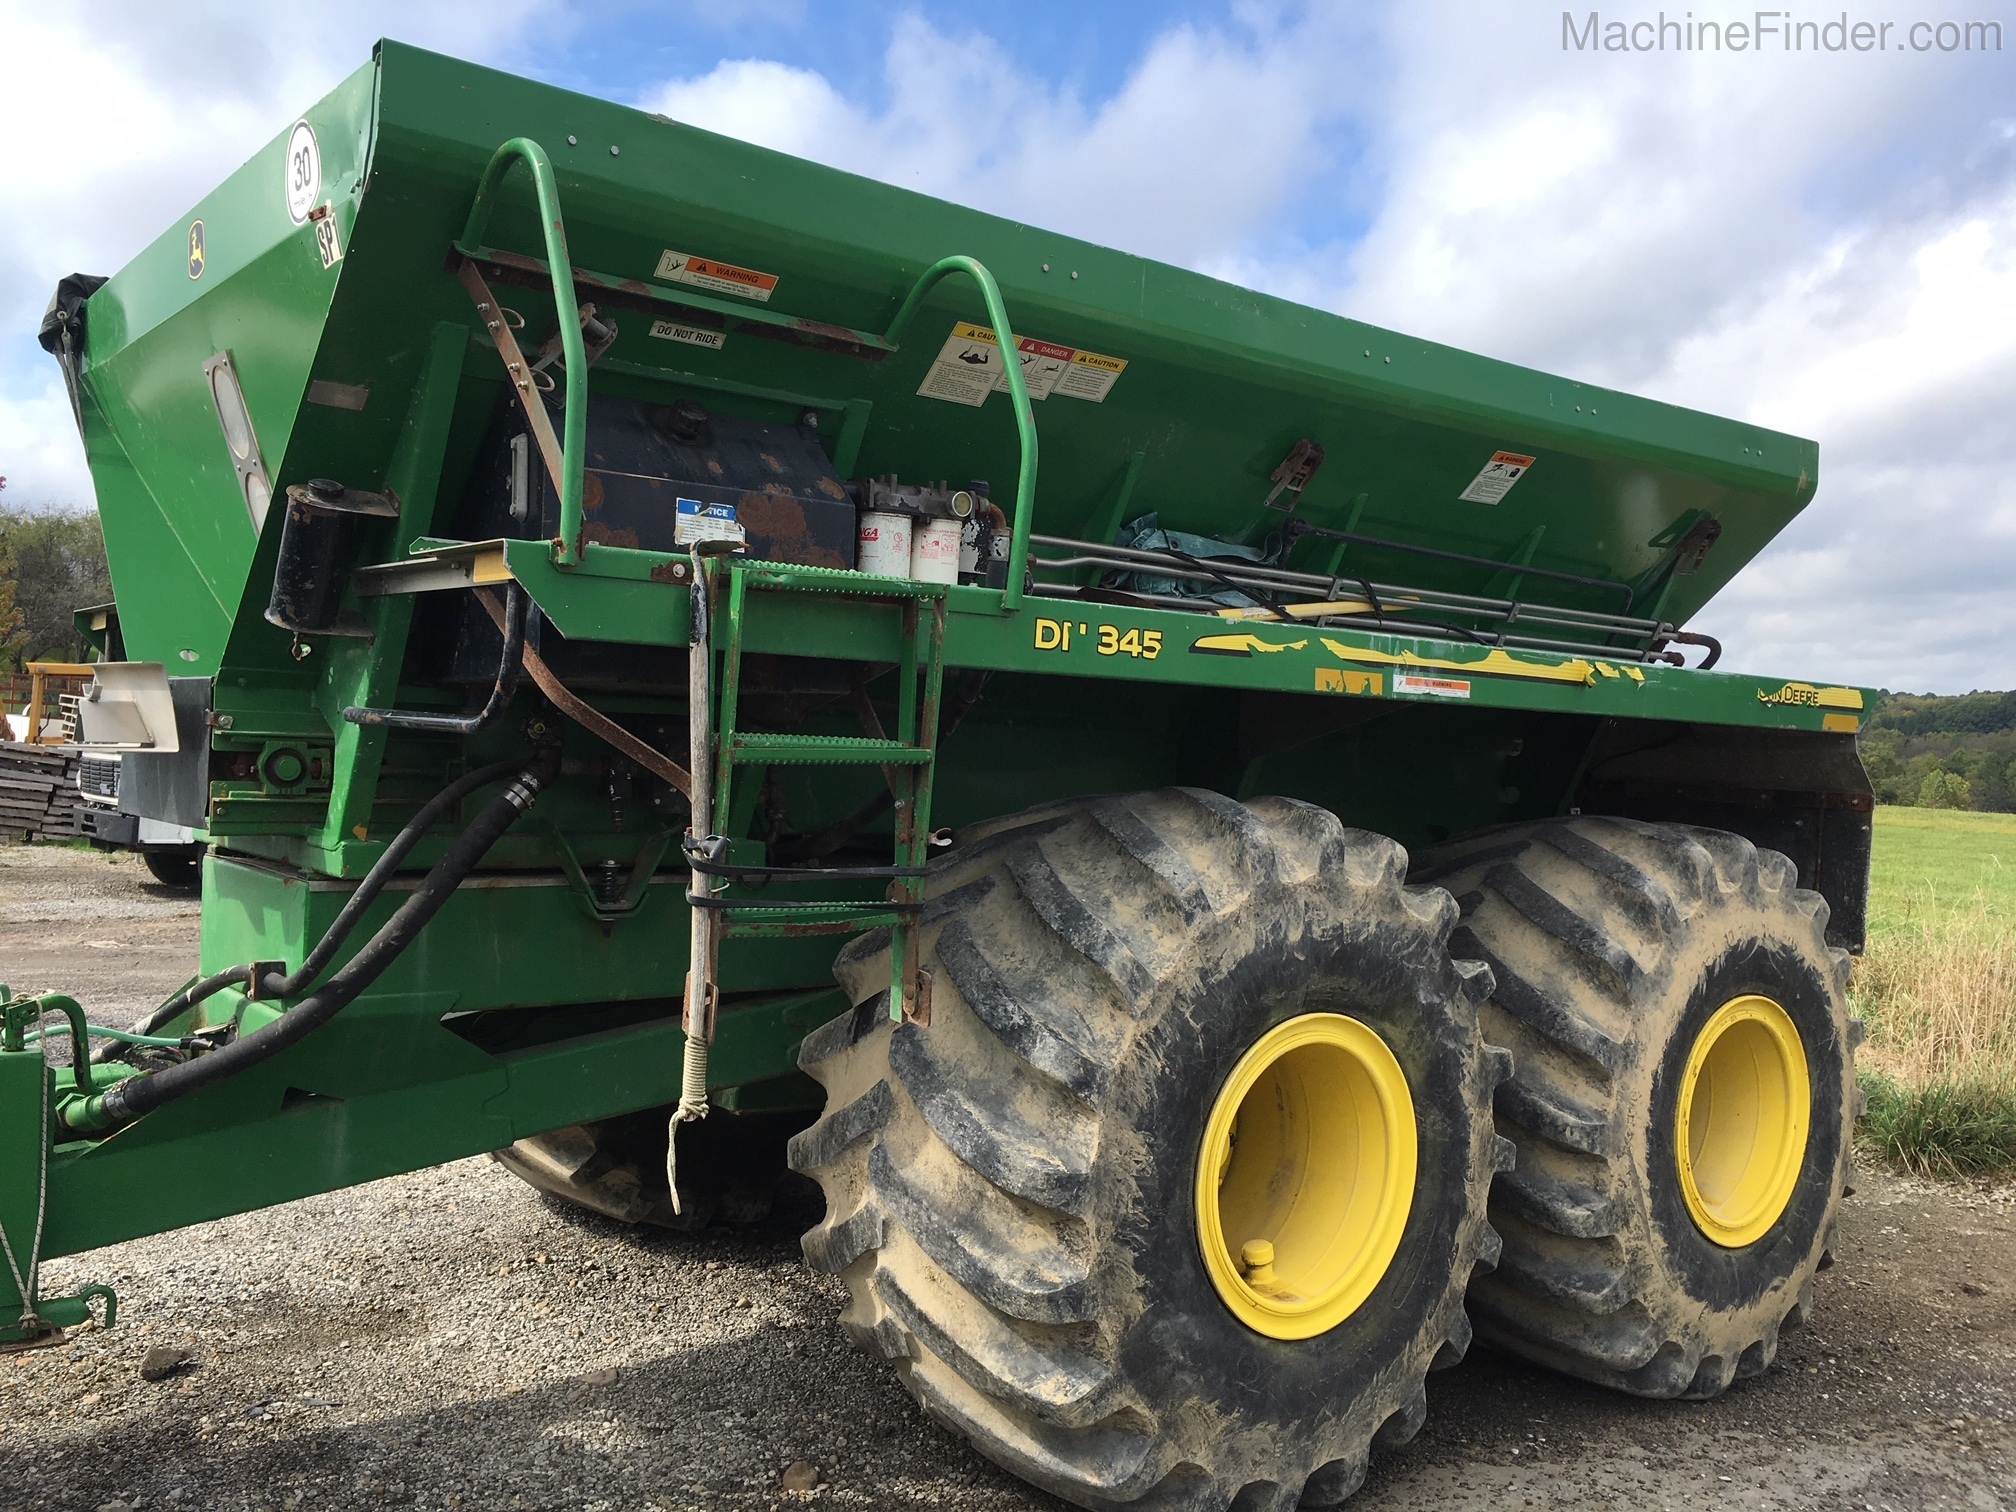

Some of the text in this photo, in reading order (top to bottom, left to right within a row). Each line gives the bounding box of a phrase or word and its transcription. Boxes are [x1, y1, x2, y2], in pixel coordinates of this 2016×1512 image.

[294, 146, 311, 191] 30
[318, 219, 342, 265] SP1
[716, 266, 759, 283] WARNING
[657, 325, 718, 345] DO NOT RIDE
[977, 331, 998, 342] CAUT
[1041, 346, 1068, 358] DANGER
[1088, 357, 1119, 369] CAUTION
[694, 505, 728, 517] NTICE
[1096, 623, 1163, 660] 345
[1784, 685, 1819, 704] DEERE
